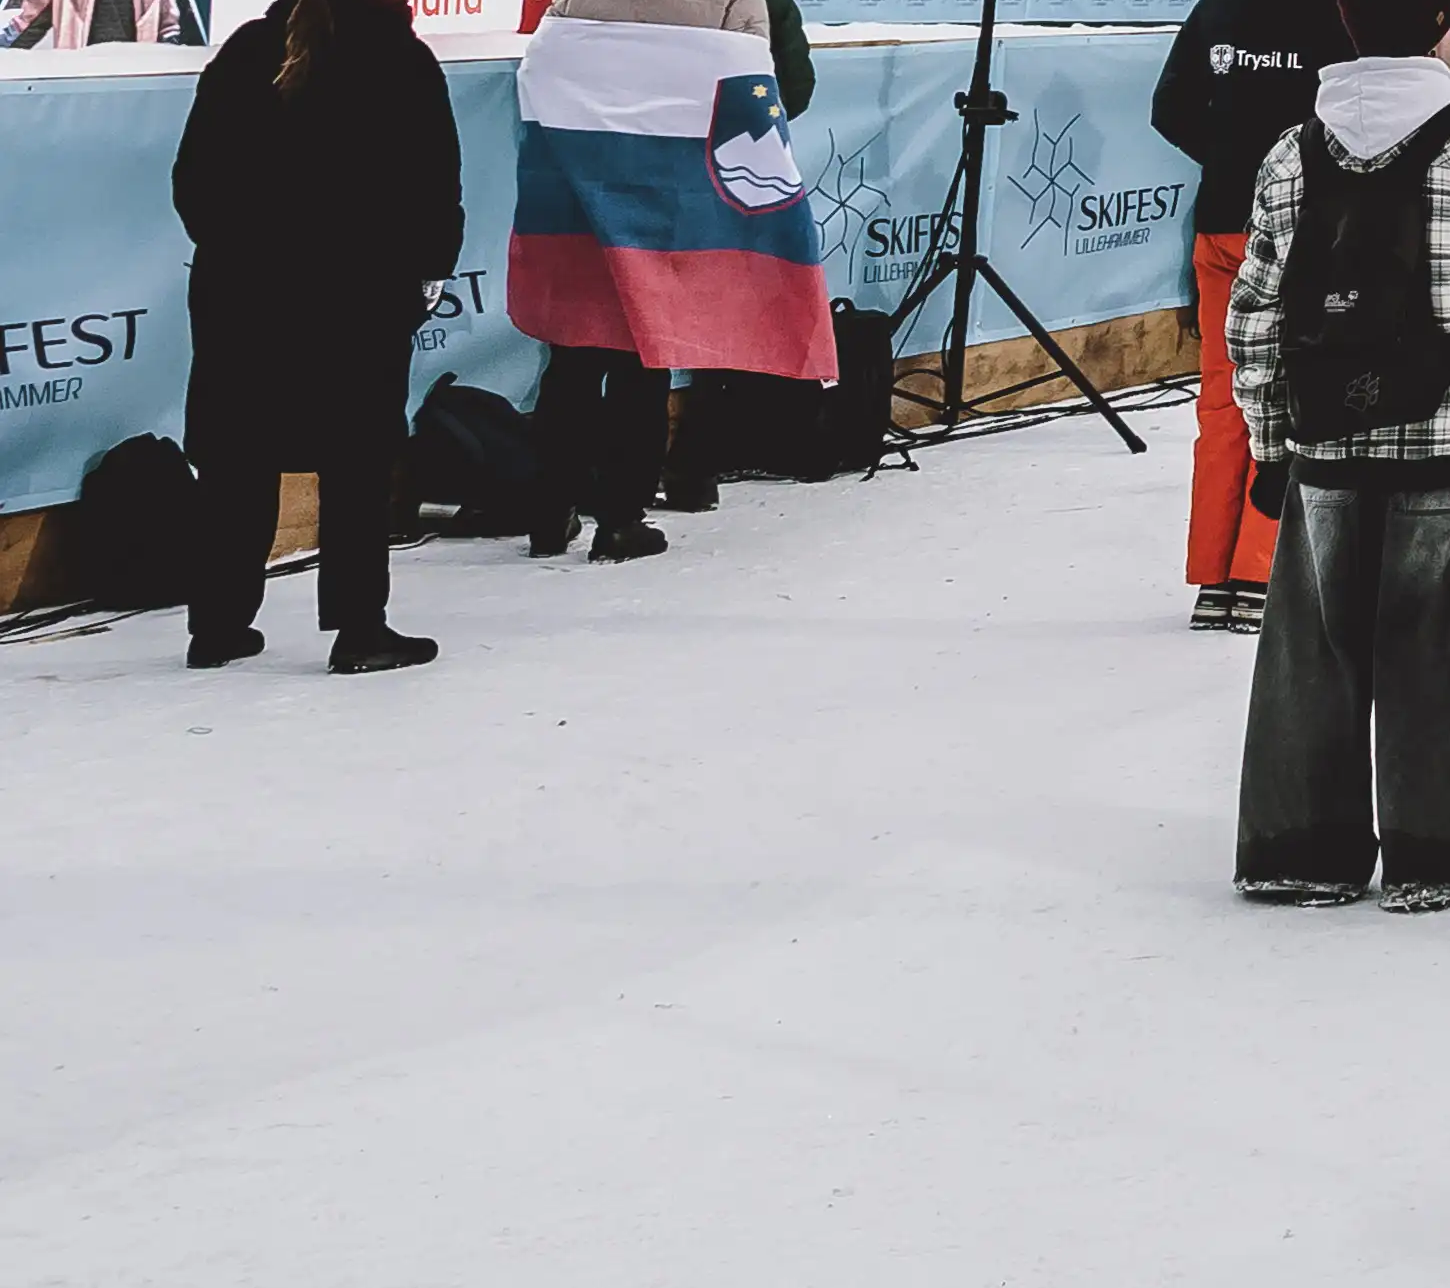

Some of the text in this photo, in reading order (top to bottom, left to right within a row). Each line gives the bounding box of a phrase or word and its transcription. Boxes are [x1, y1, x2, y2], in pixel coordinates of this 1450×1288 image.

[1236, 49, 1303, 71] Trysil IL
[1077, 184, 1185, 231] SKIFEST
[864, 211, 963, 258] SKIFES
[1075, 228, 1151, 255] LILLEHAMMER
[0, 308, 148, 374] FEST
